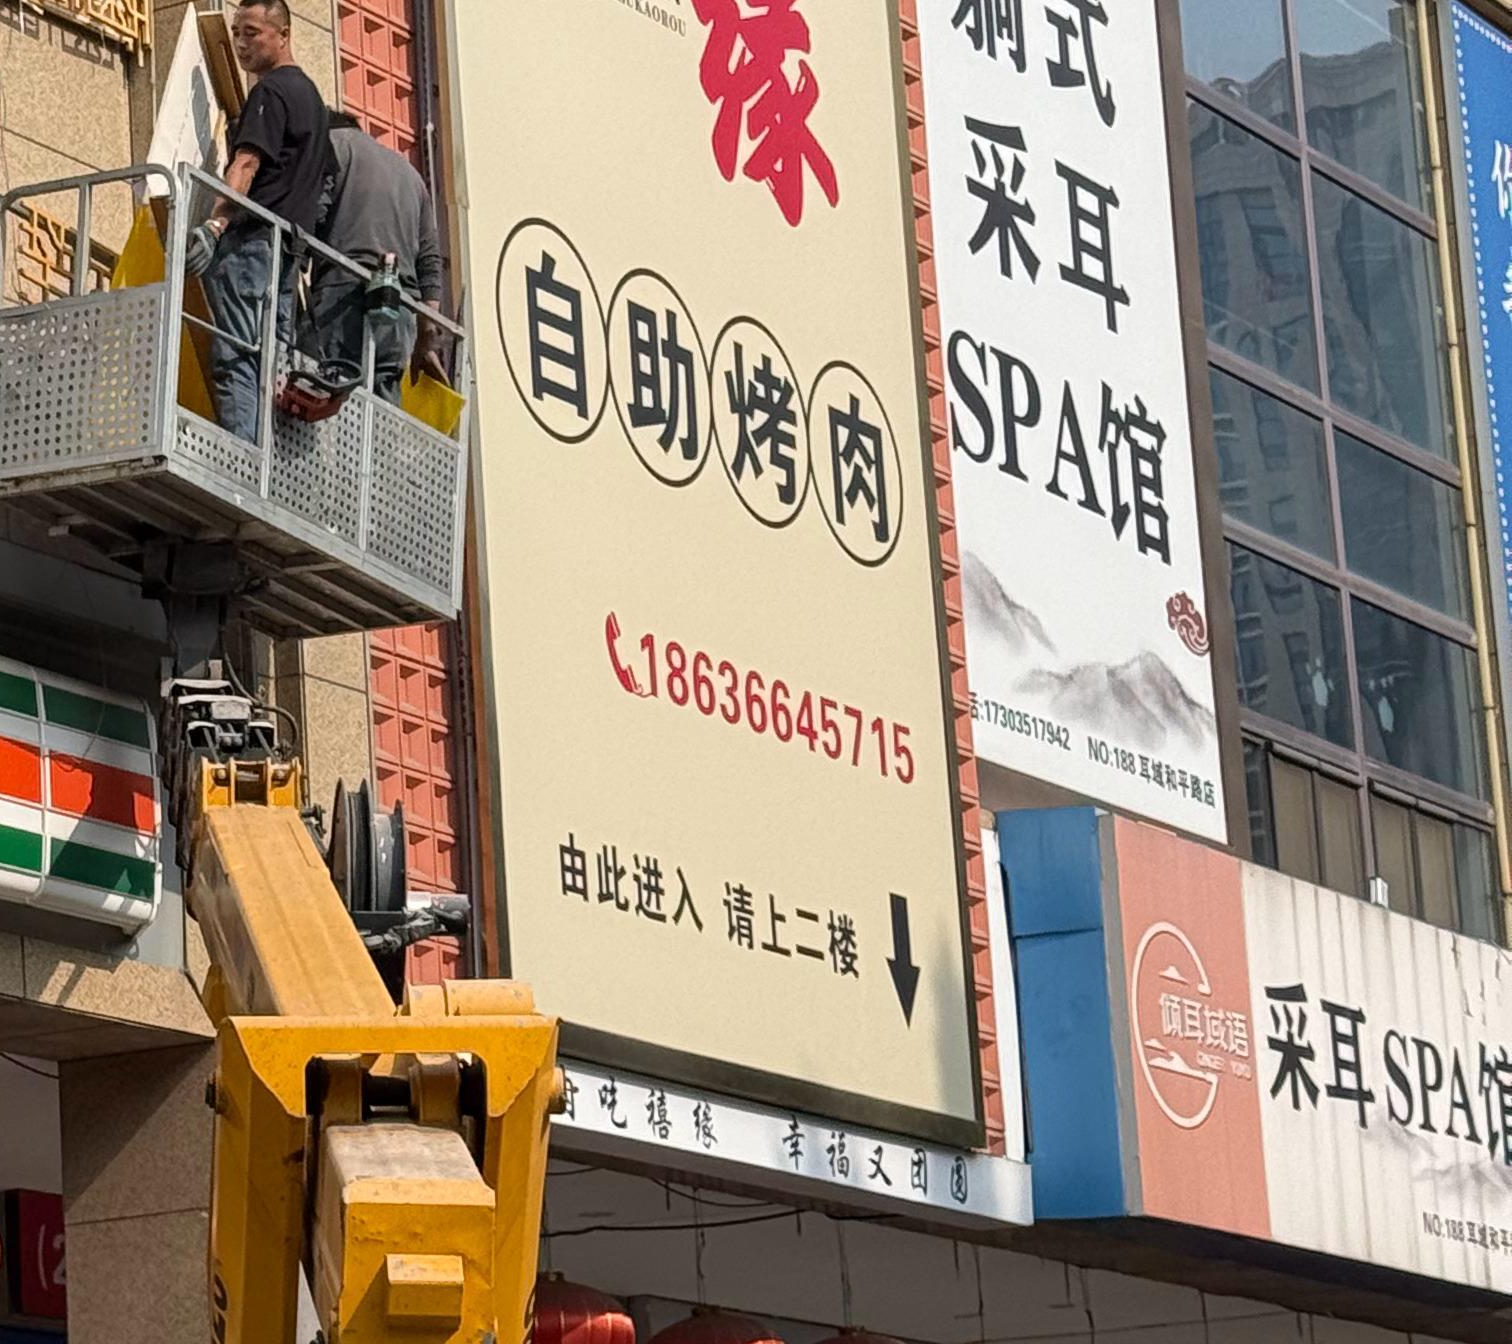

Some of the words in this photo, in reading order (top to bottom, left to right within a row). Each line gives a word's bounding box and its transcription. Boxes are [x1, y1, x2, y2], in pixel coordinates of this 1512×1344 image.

[963, 115, 1131, 335] 采耳
[525, 250, 890, 544] 自助烤肉
[947, 329, 1172, 567] SPA馆
[639, 632, 915, 784] 18636645715
[1087, 736, 1136, 776] NO:188
[559, 832, 704, 934] 由此进入
[722, 882, 860, 979] 请上二楼
[782, 1115, 969, 1205] 幸福又团圆
